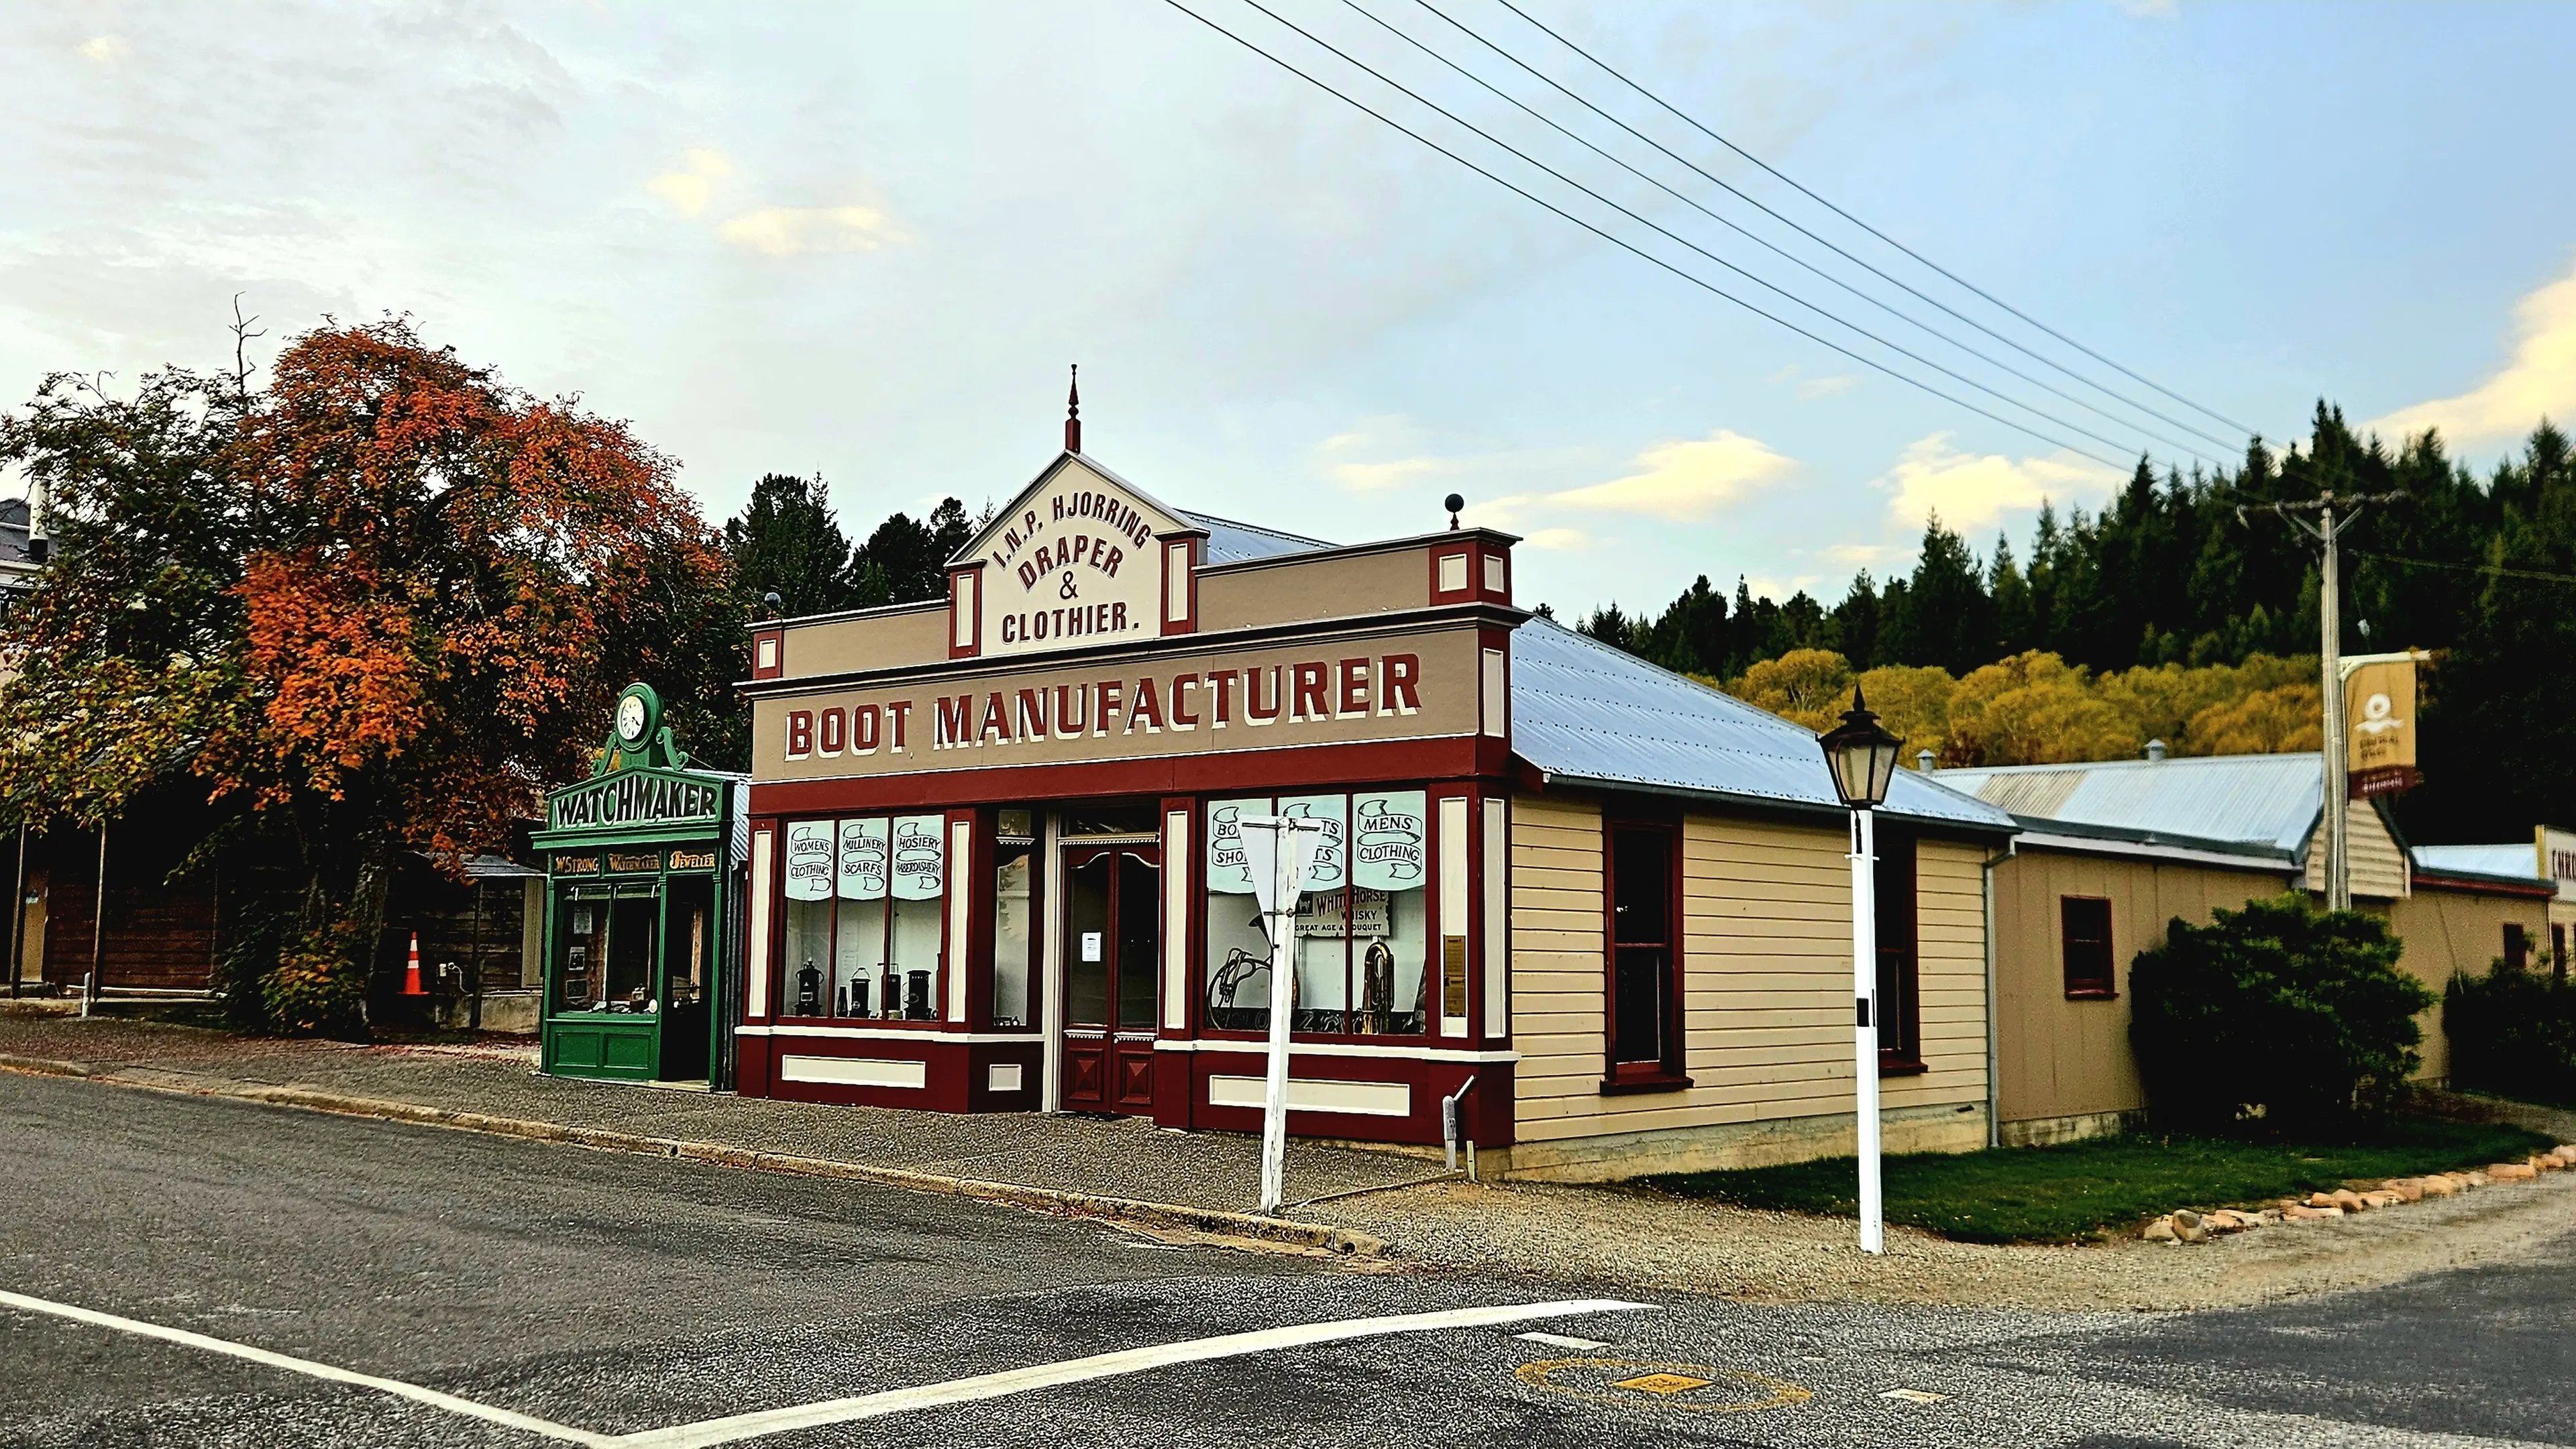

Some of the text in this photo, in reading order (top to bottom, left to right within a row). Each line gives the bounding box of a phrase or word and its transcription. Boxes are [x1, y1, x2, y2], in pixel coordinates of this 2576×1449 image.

[1052, 491, 1151, 550] HJORRING
[1016, 535, 1123, 592] DRAPER
[1059, 570, 1078, 599] &
[1002, 602, 1139, 644] CLOTHIER.
[784, 653, 1422, 762] BOOT MANUFACTURER
[556, 775, 717, 828] WATCHMAKER
[1363, 817, 1413, 831] MENS
[794, 841, 829, 852] WOMENS
[843, 839, 885, 851] MILLINERY
[899, 837, 940, 849] HOSIERY
[1216, 851, 1248, 863] SHO
[1359, 844, 1419, 861] CLOTHING
[845, 862, 882, 875] SCARFS
[1316, 893, 1347, 917] WHIT
[1340, 910, 1377, 920] WISKY
[1352, 923, 1381, 932] OUQUET
